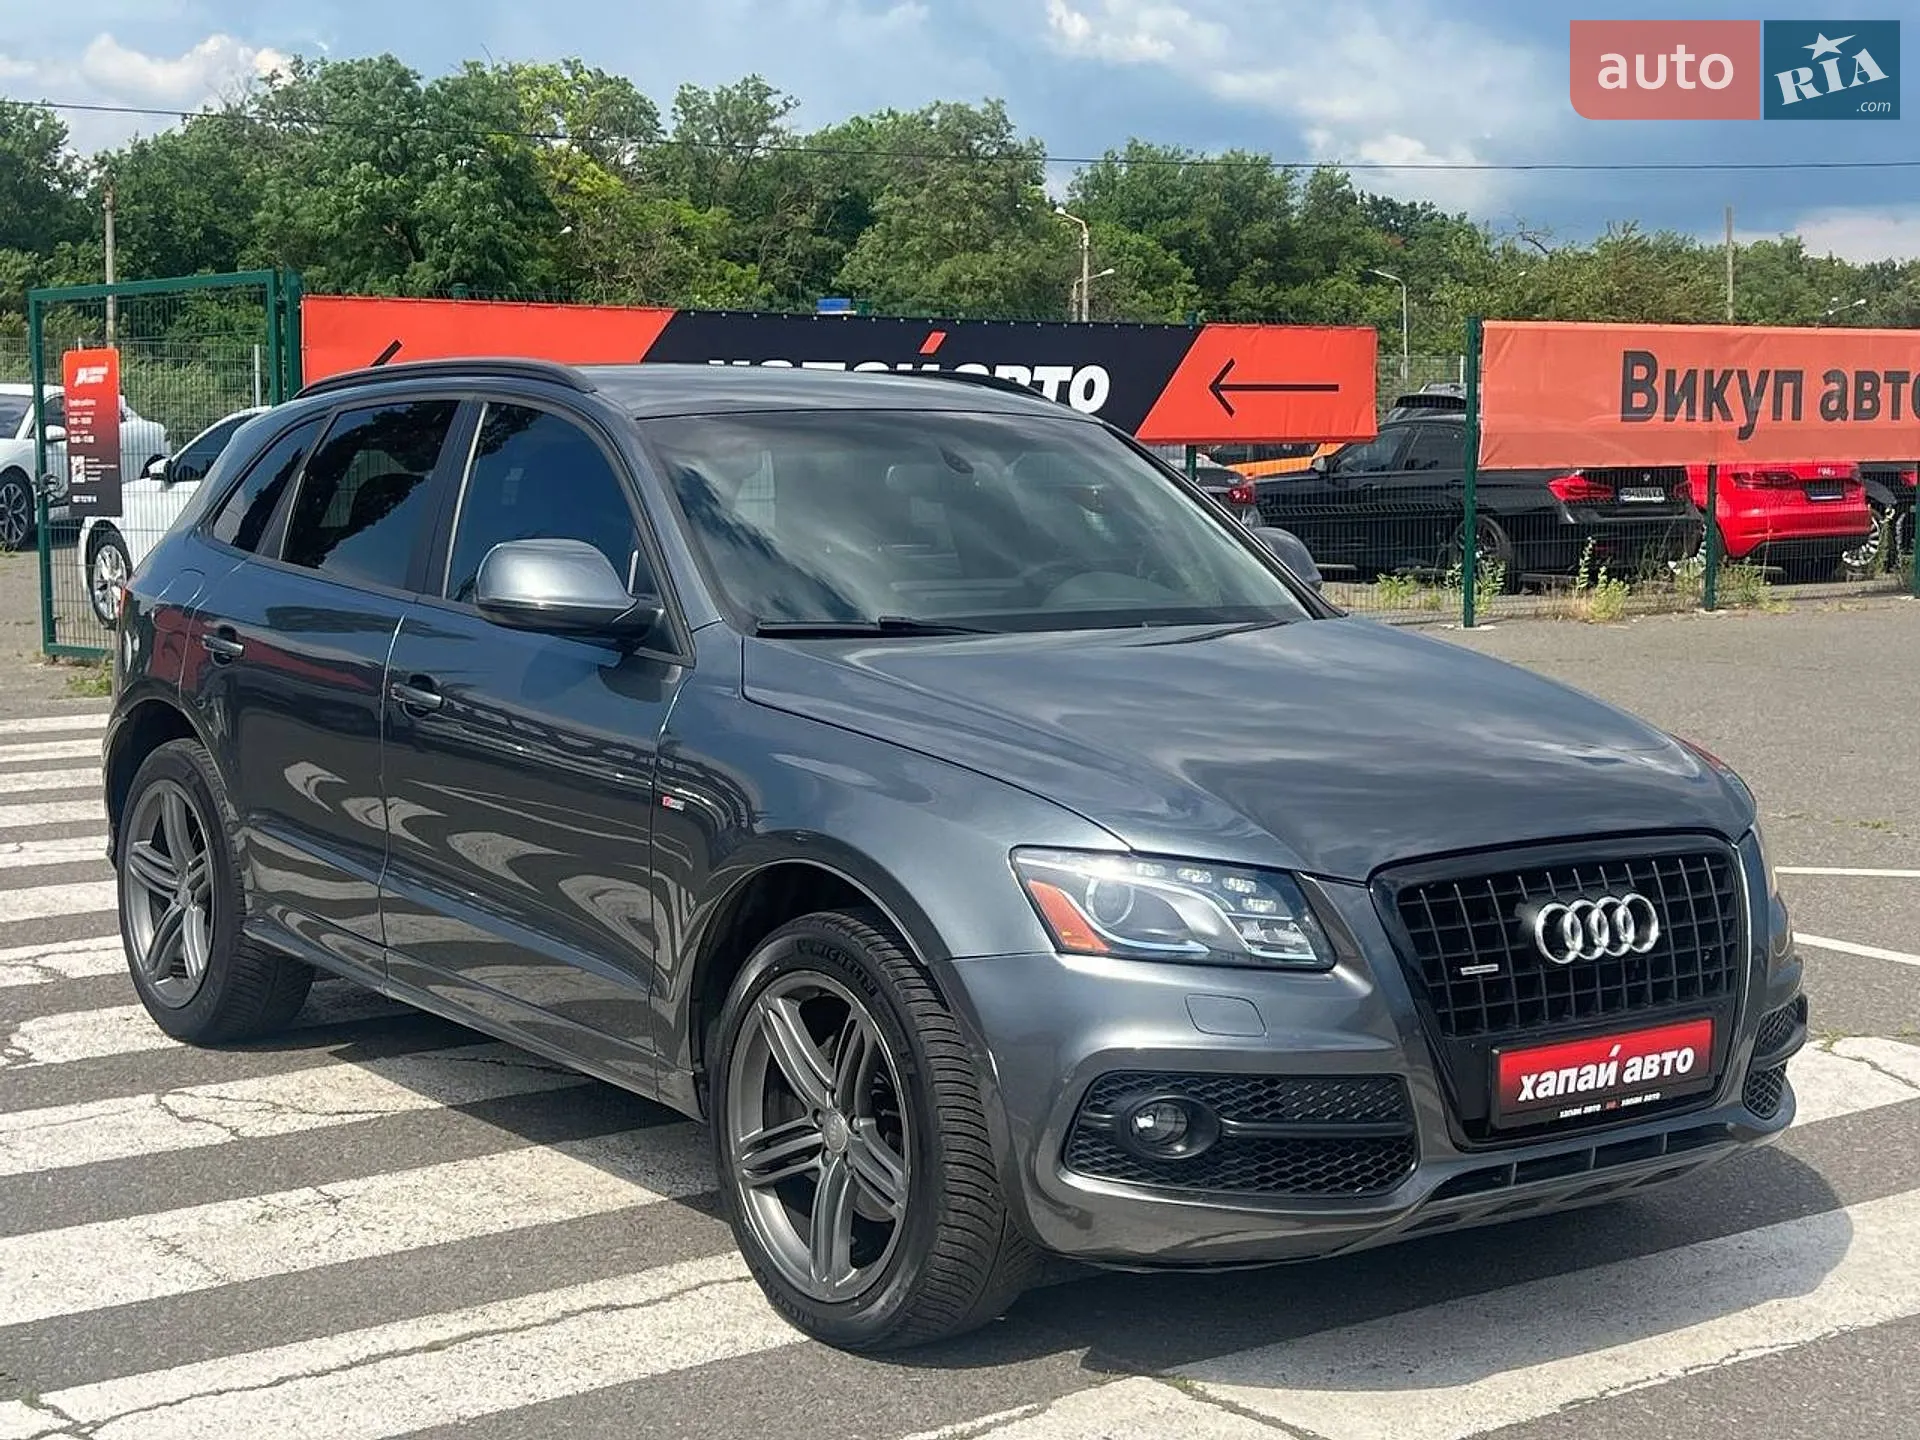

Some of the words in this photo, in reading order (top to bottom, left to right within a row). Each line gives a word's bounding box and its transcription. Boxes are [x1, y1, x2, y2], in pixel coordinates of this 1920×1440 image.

[1620, 350, 1803, 441] Викуп
[1517, 1044, 1622, 1102] хапай
[1622, 1046, 1695, 1084] авто
